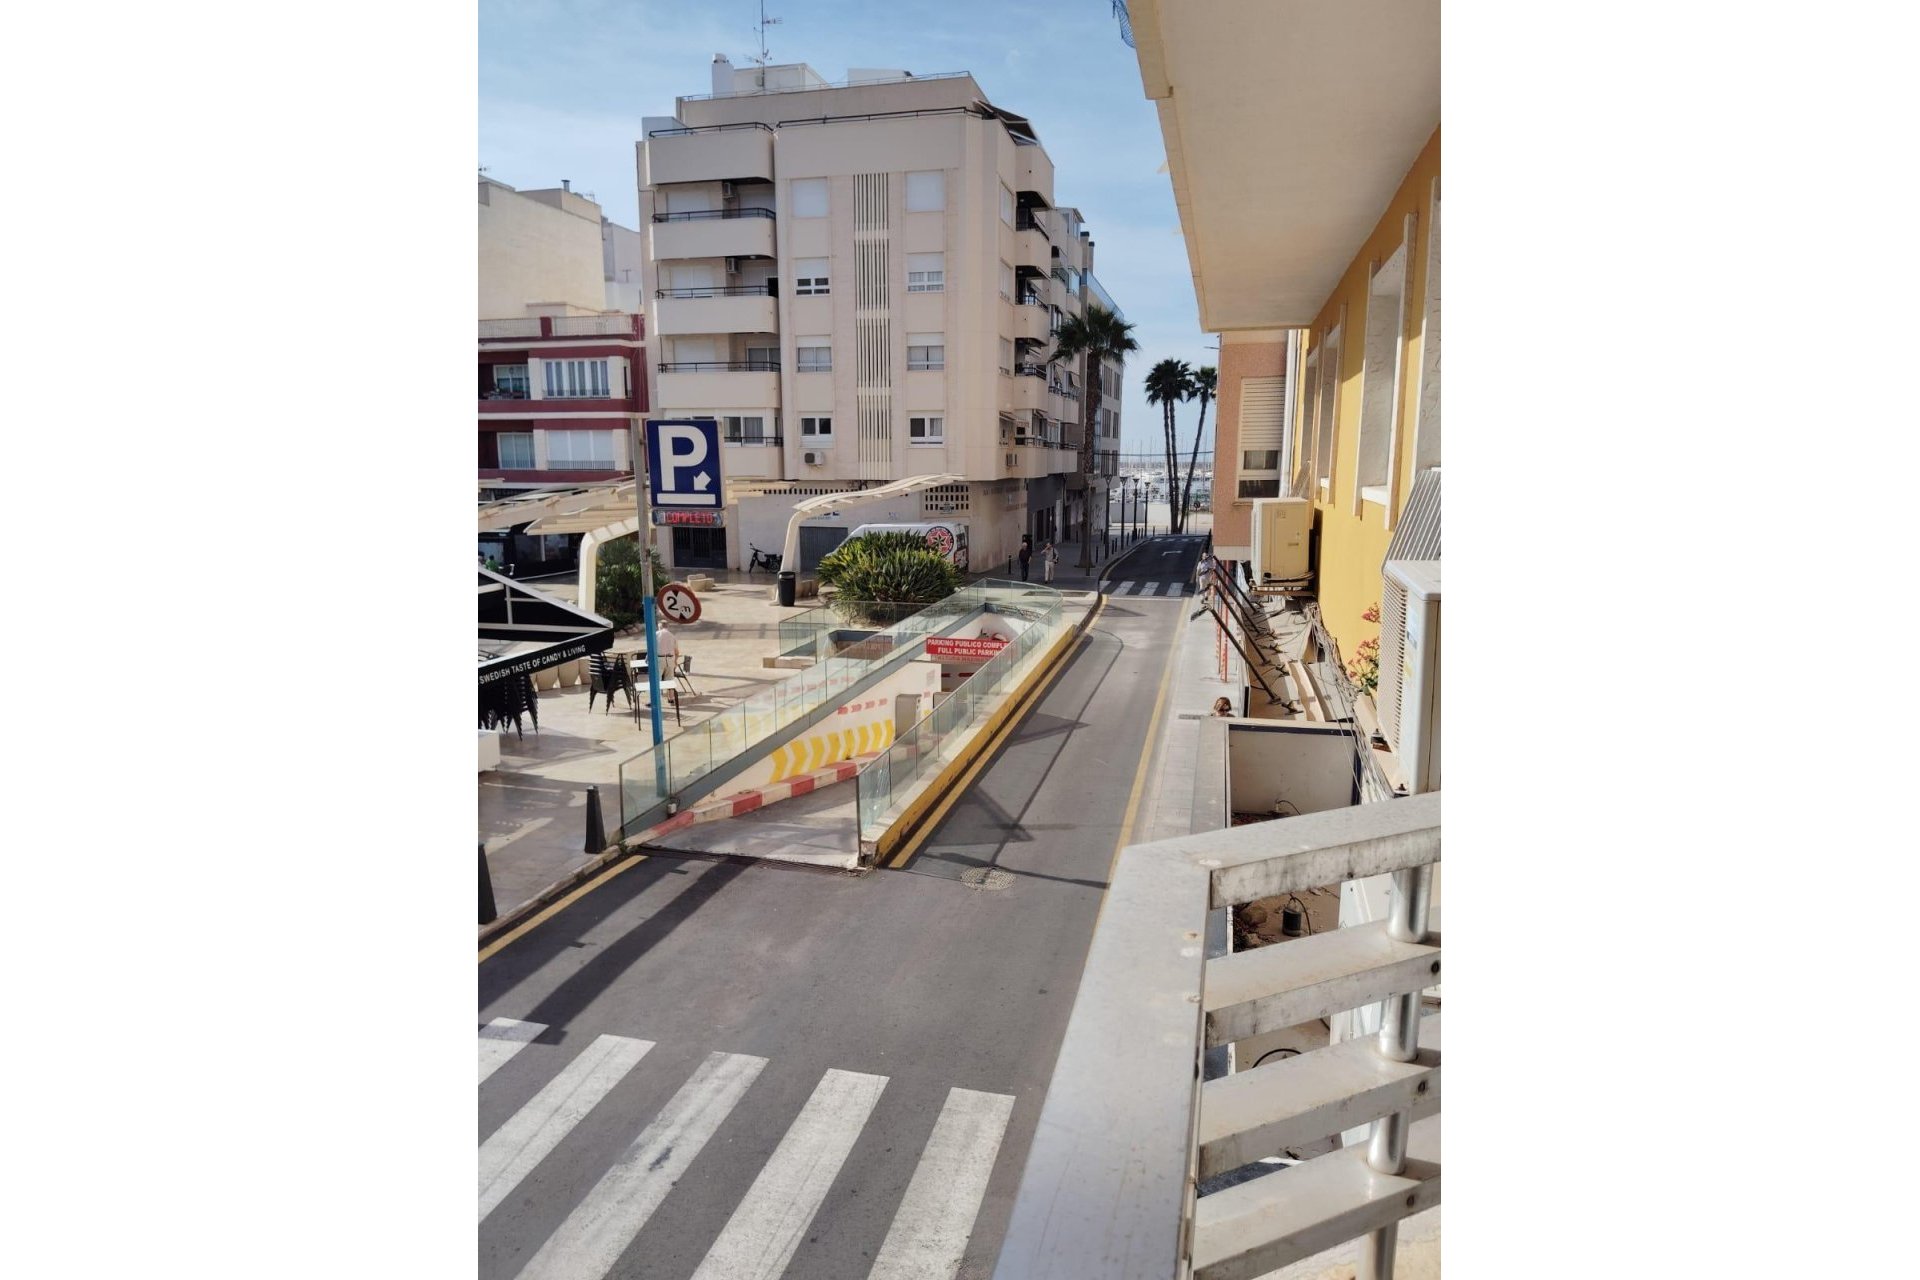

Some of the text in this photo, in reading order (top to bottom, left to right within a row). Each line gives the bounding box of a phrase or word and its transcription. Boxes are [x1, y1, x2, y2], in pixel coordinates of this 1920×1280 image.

[658, 425, 708, 491] P
[665, 511, 714, 524] COMPLETO
[666, 596, 679, 611] 2
[927, 639, 954, 647] PARKING
[955, 640, 982, 648] PUBLICO
[479, 644, 586, 685] SWEDISH TASTE OF CANDY & LIVING
